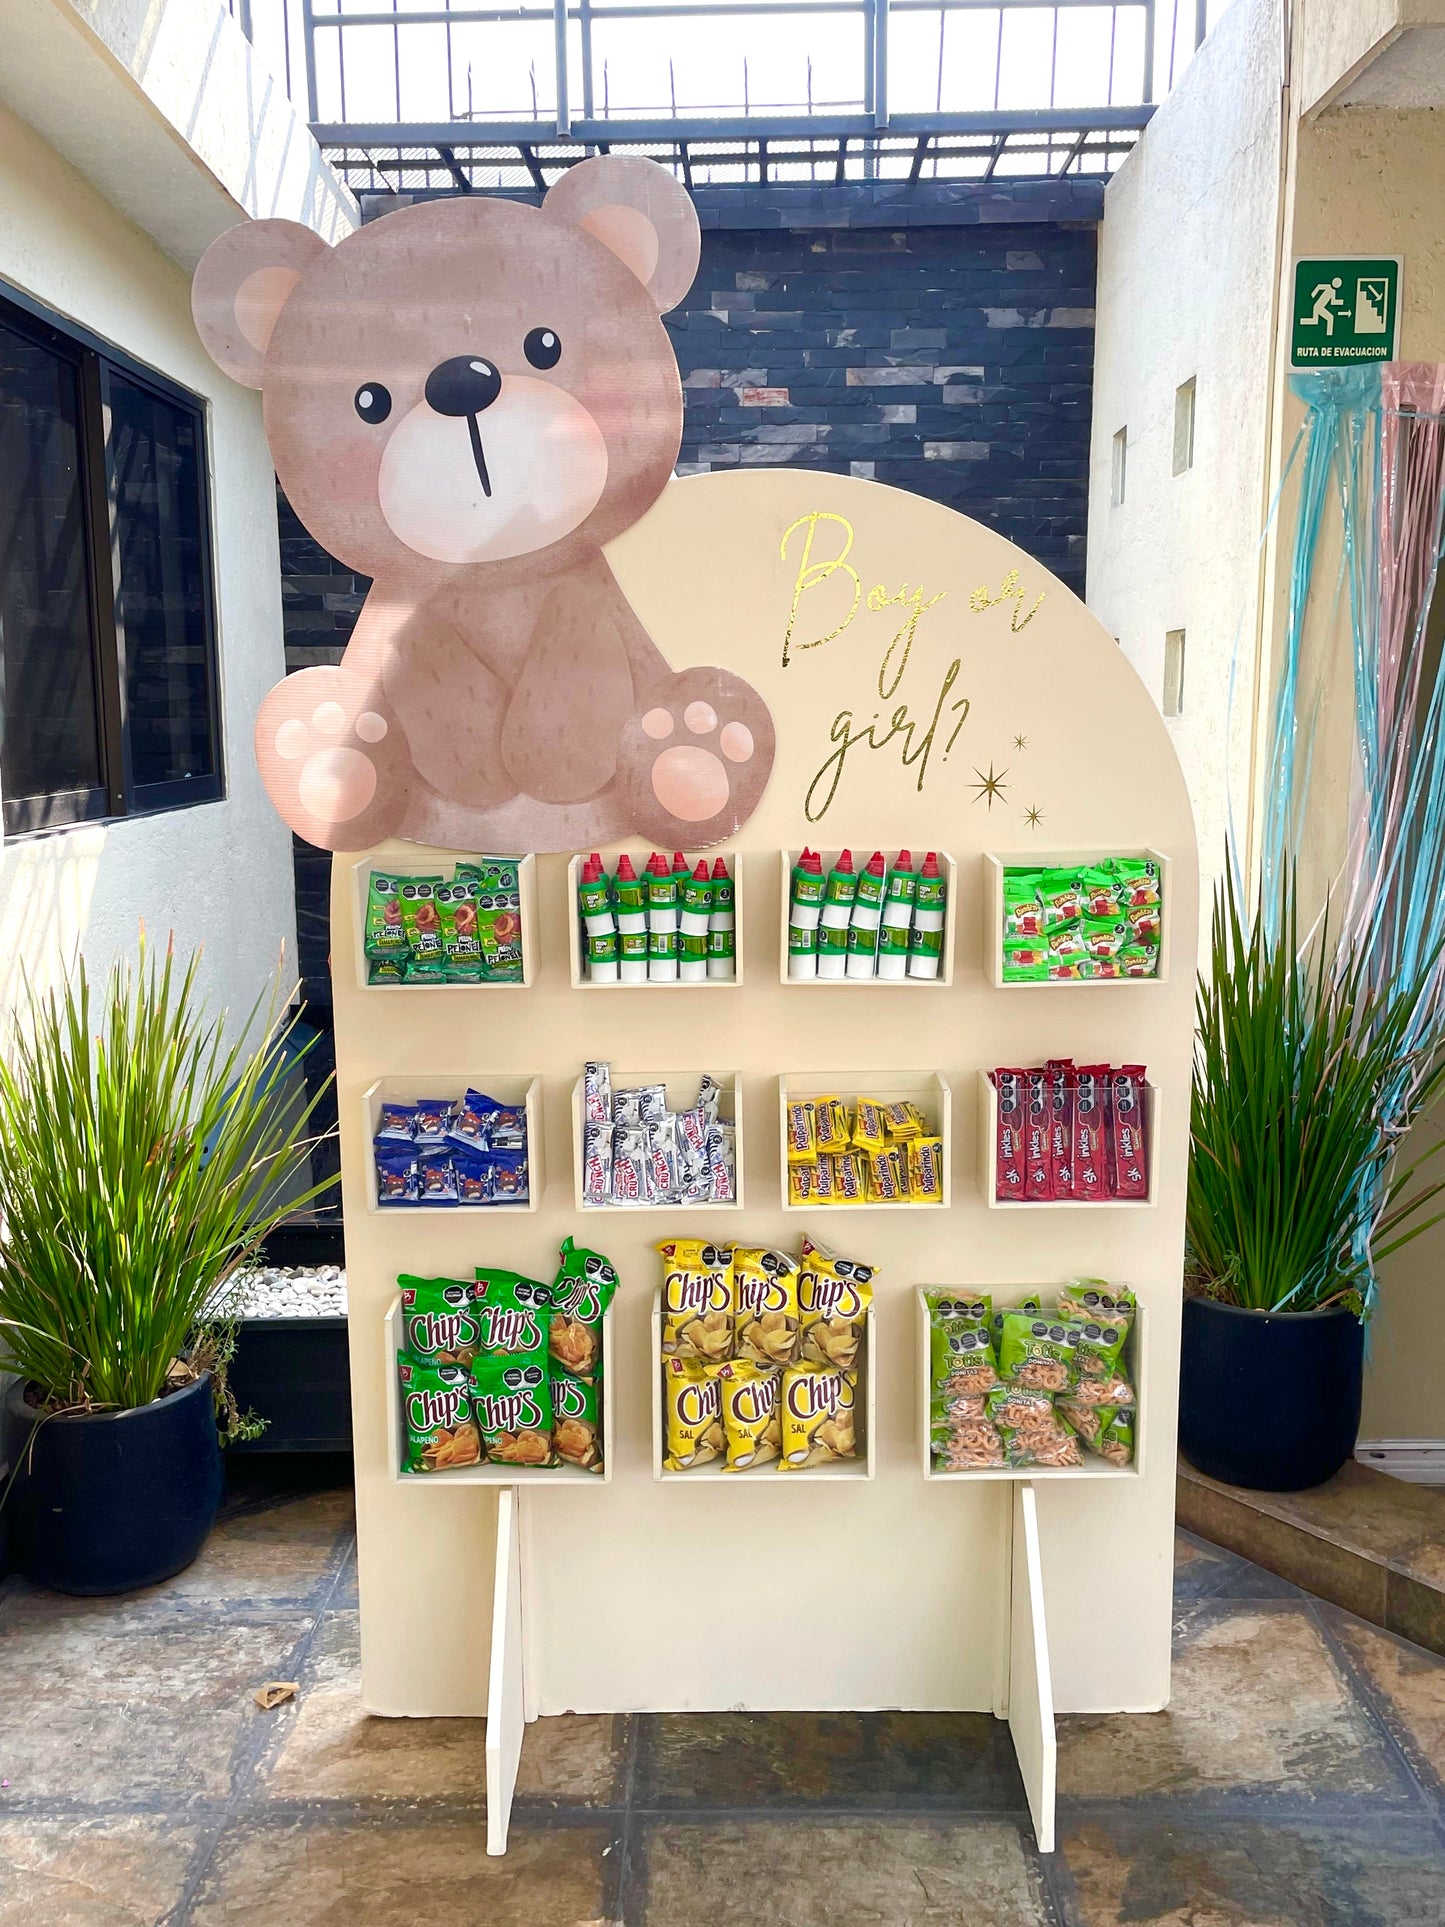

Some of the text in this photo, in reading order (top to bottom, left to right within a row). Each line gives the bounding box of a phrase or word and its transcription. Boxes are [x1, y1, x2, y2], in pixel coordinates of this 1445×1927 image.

[1297, 347, 1387, 357] RUTA DE EVACUACION
[780, 510, 1046, 700] Boy or
[804, 658, 970, 824] girl?
[792, 1105, 809, 1151] Pulparindo
[621, 1158, 638, 1198] CRUNCH
[652, 1150, 670, 1189] CRUNCH
[920, 1146, 936, 1193] Pulparindo
[551, 1377, 586, 1418] ip's
[679, 1430, 694, 1439] SAL
[738, 1430, 753, 1439] SAL
[791, 1424, 806, 1433] SAL
